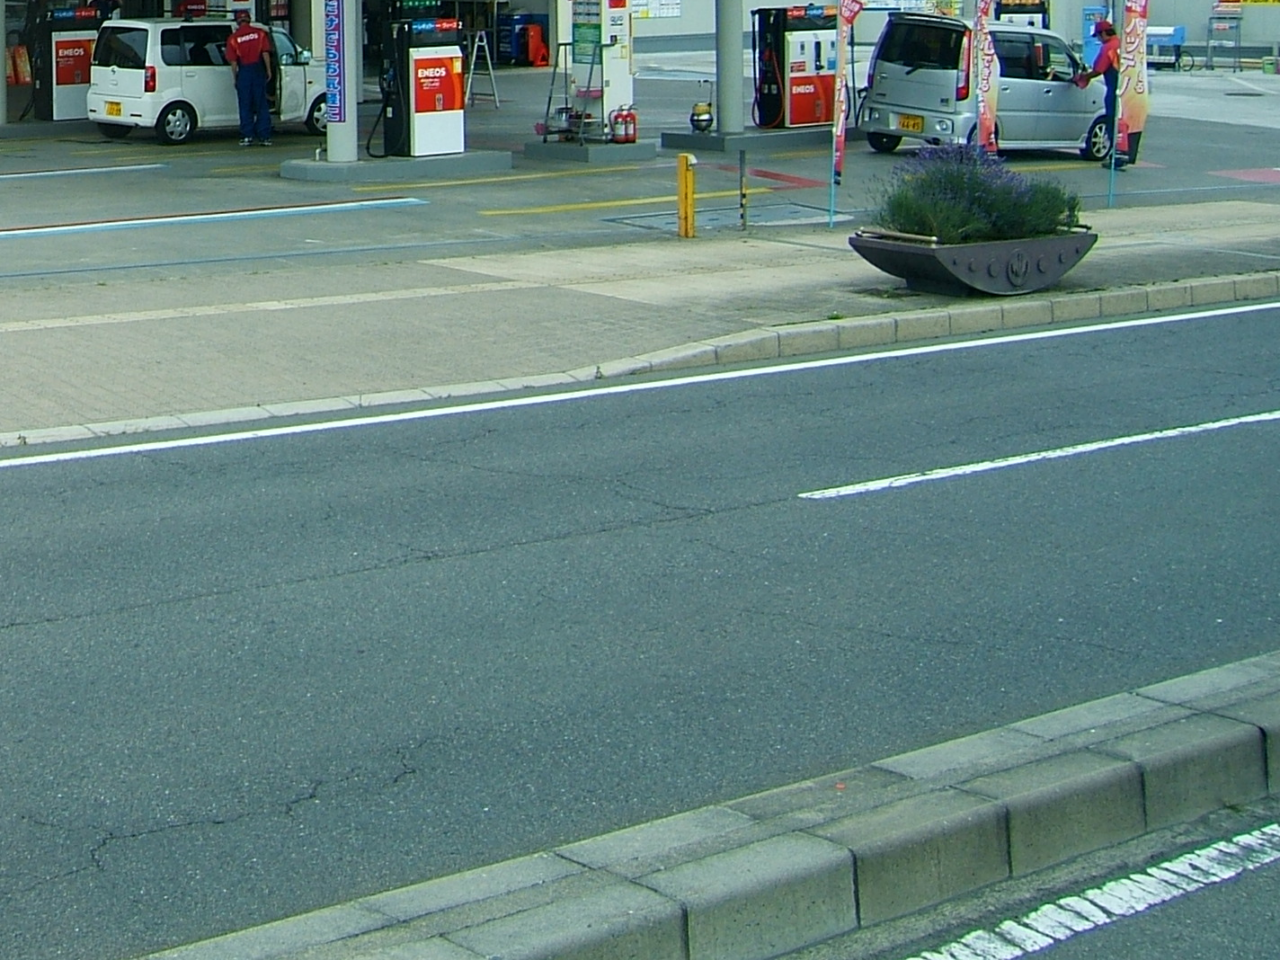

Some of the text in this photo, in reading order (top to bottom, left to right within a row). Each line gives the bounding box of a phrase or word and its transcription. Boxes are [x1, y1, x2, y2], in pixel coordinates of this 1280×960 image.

[237, 33, 259, 43] ENEOS
[58, 48, 85, 57] ENEOS
[417, 67, 446, 77] ENEOS
[792, 85, 814, 93] ENEOS
